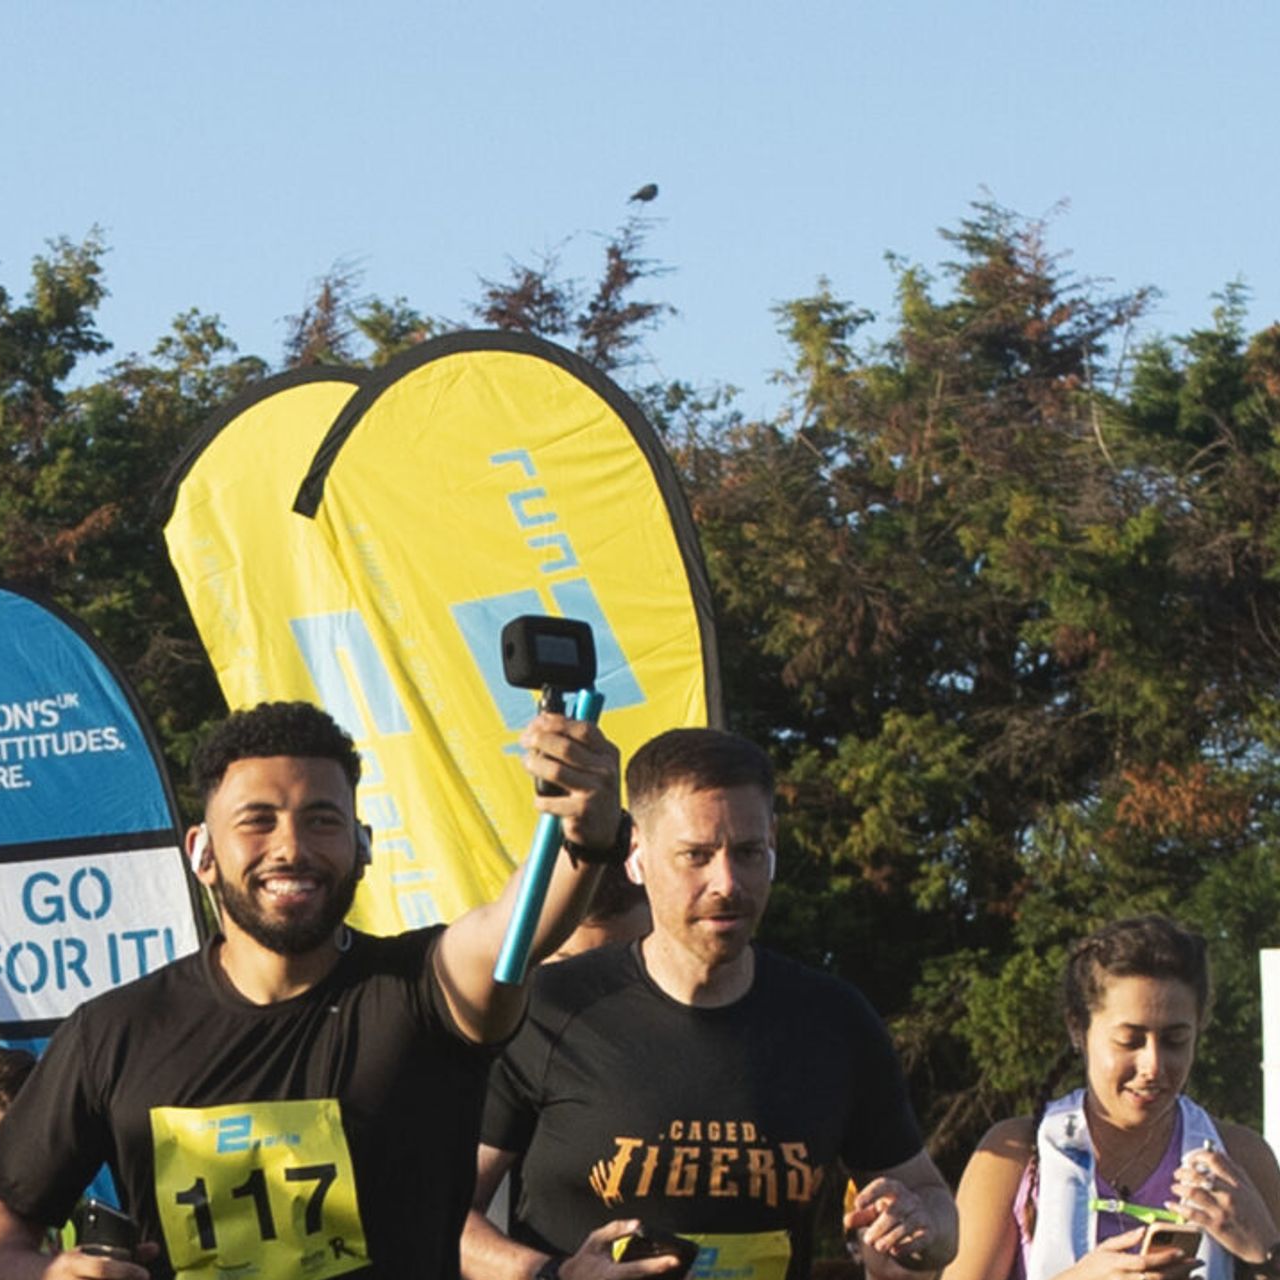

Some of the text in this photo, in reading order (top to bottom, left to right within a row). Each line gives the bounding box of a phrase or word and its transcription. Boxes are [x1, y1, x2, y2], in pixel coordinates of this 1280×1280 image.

[21, 867, 113, 926] GO
[670, 1120, 757, 1143] CAGED
[589, 1136, 823, 1208] TIGERS
[176, 1163, 338, 1251] 117
